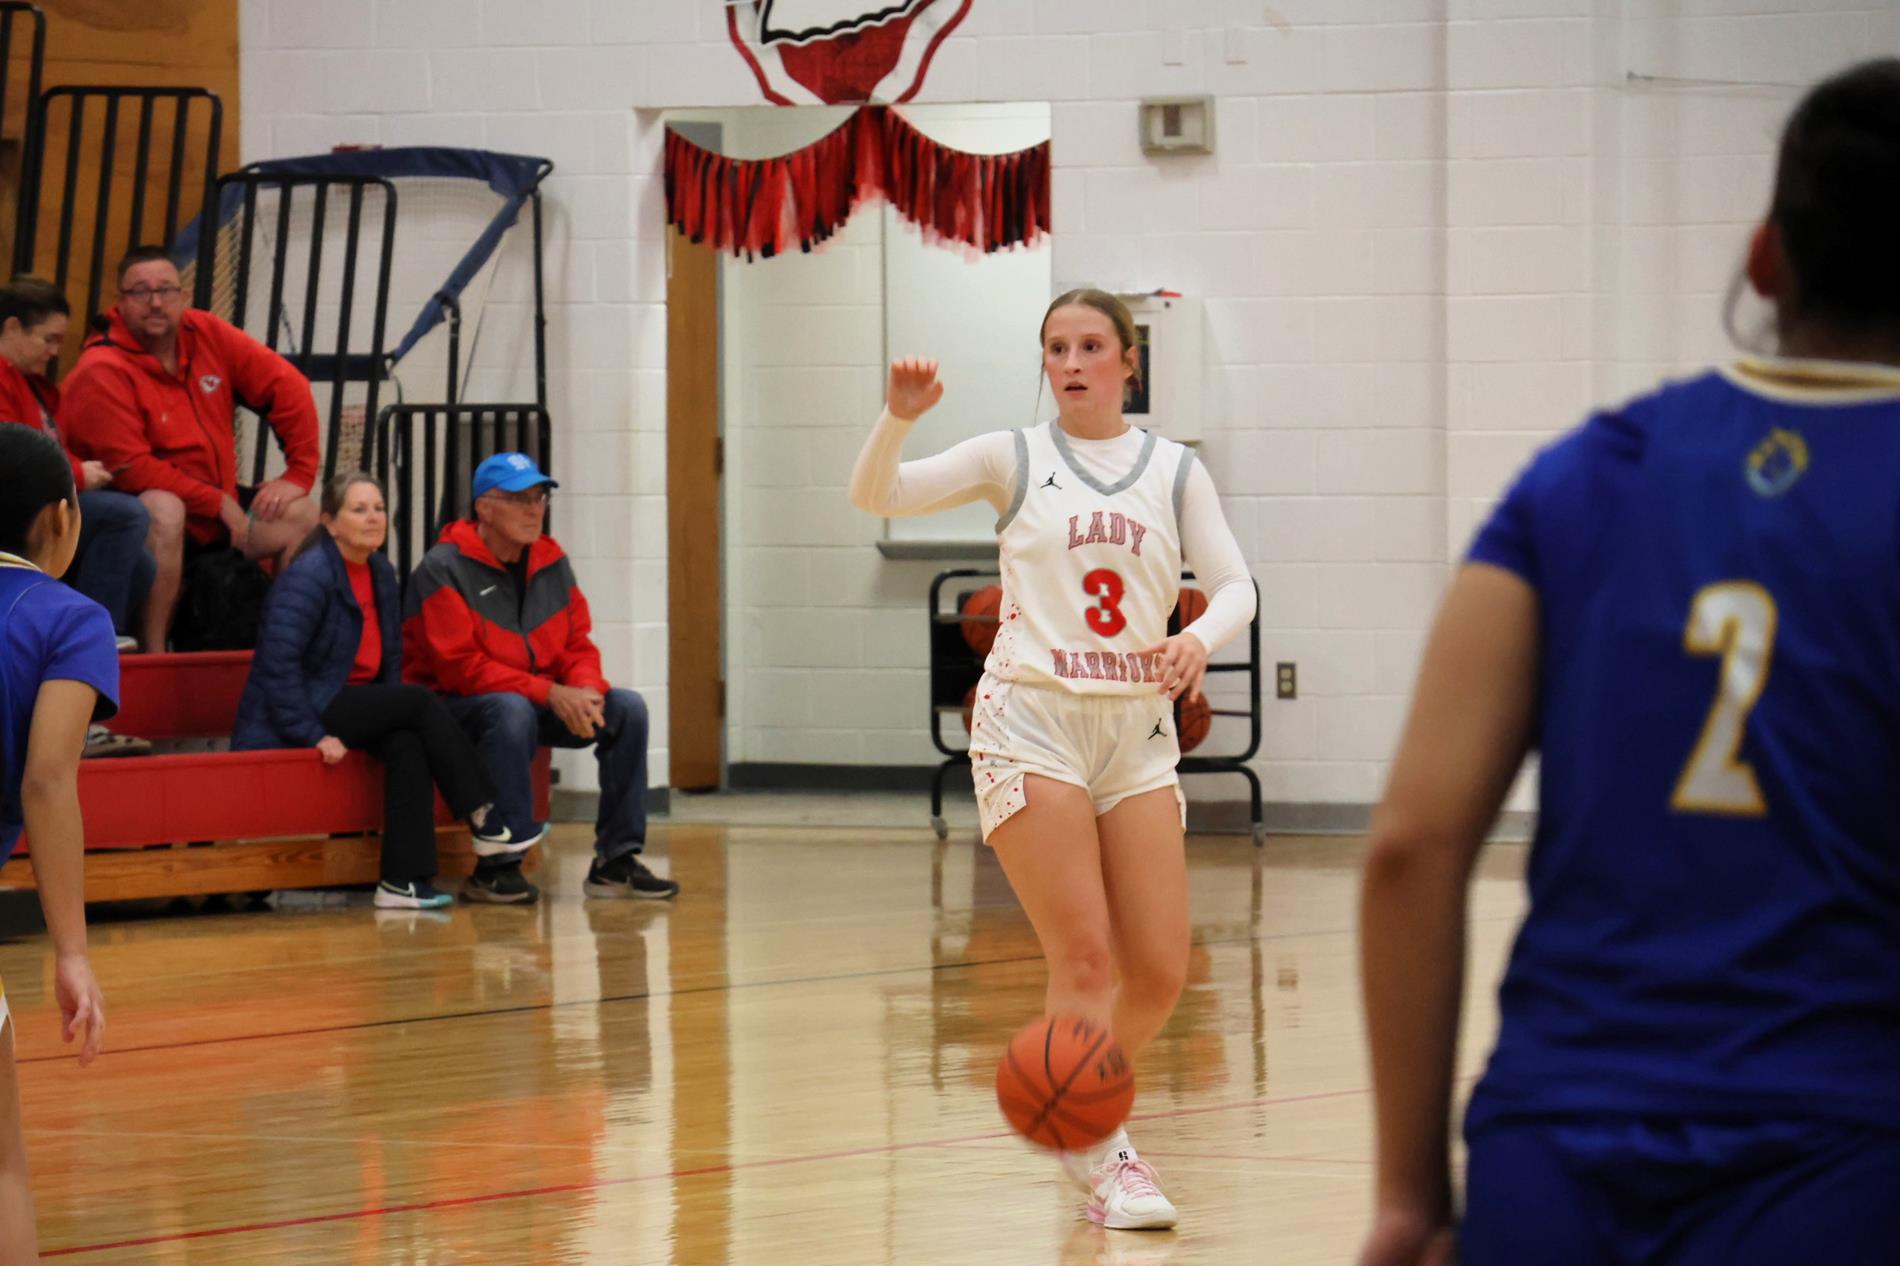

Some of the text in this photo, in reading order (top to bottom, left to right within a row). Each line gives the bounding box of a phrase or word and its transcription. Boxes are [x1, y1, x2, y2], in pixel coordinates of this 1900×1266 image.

[1068, 511, 1147, 556] LADY
[1082, 567, 1127, 637] 3
[1670, 578, 1778, 816] 2
